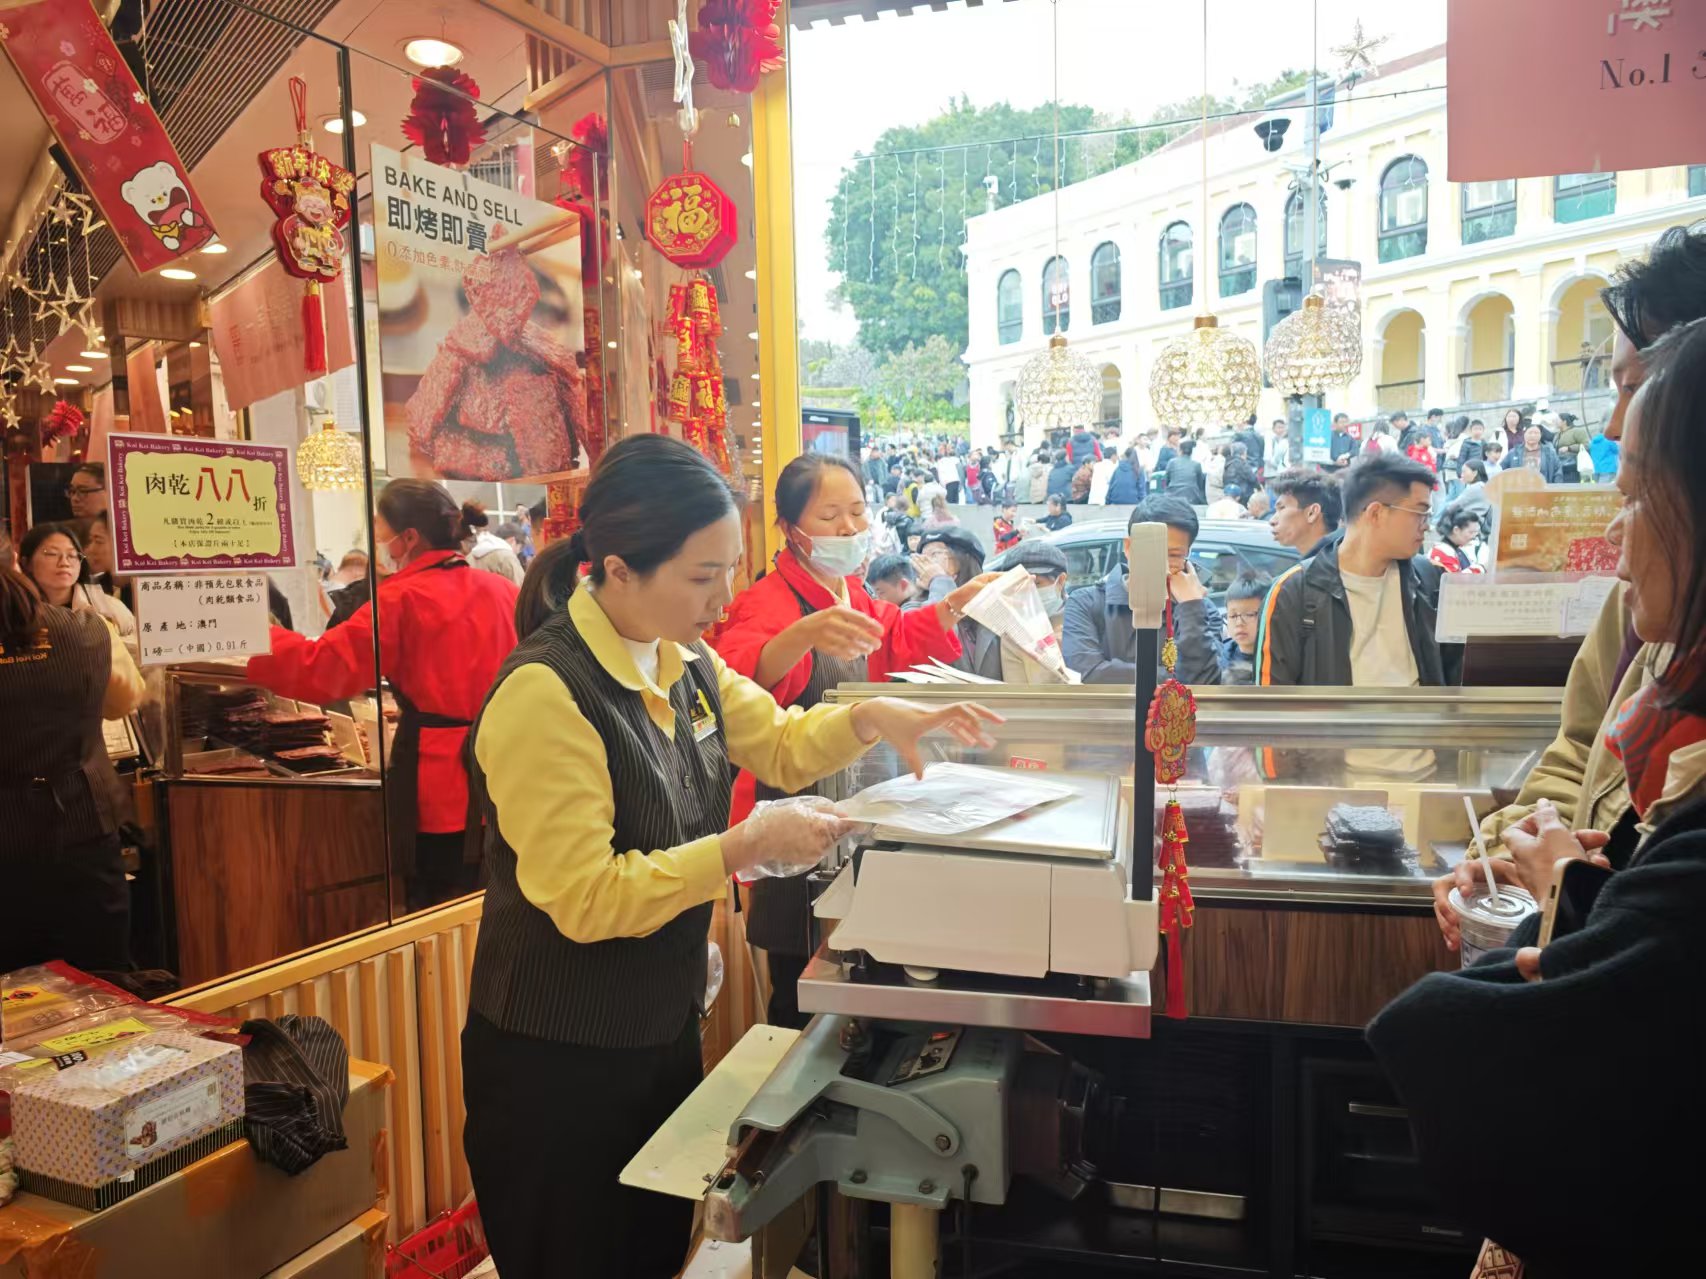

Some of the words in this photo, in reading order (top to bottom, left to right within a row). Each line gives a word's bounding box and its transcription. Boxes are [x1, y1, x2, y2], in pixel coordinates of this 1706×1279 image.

[385, 166, 437, 199] BAKE
[442, 186, 478, 211] AND
[483, 200, 523, 226] SELL
[387, 195, 489, 255] 即烤即賣
